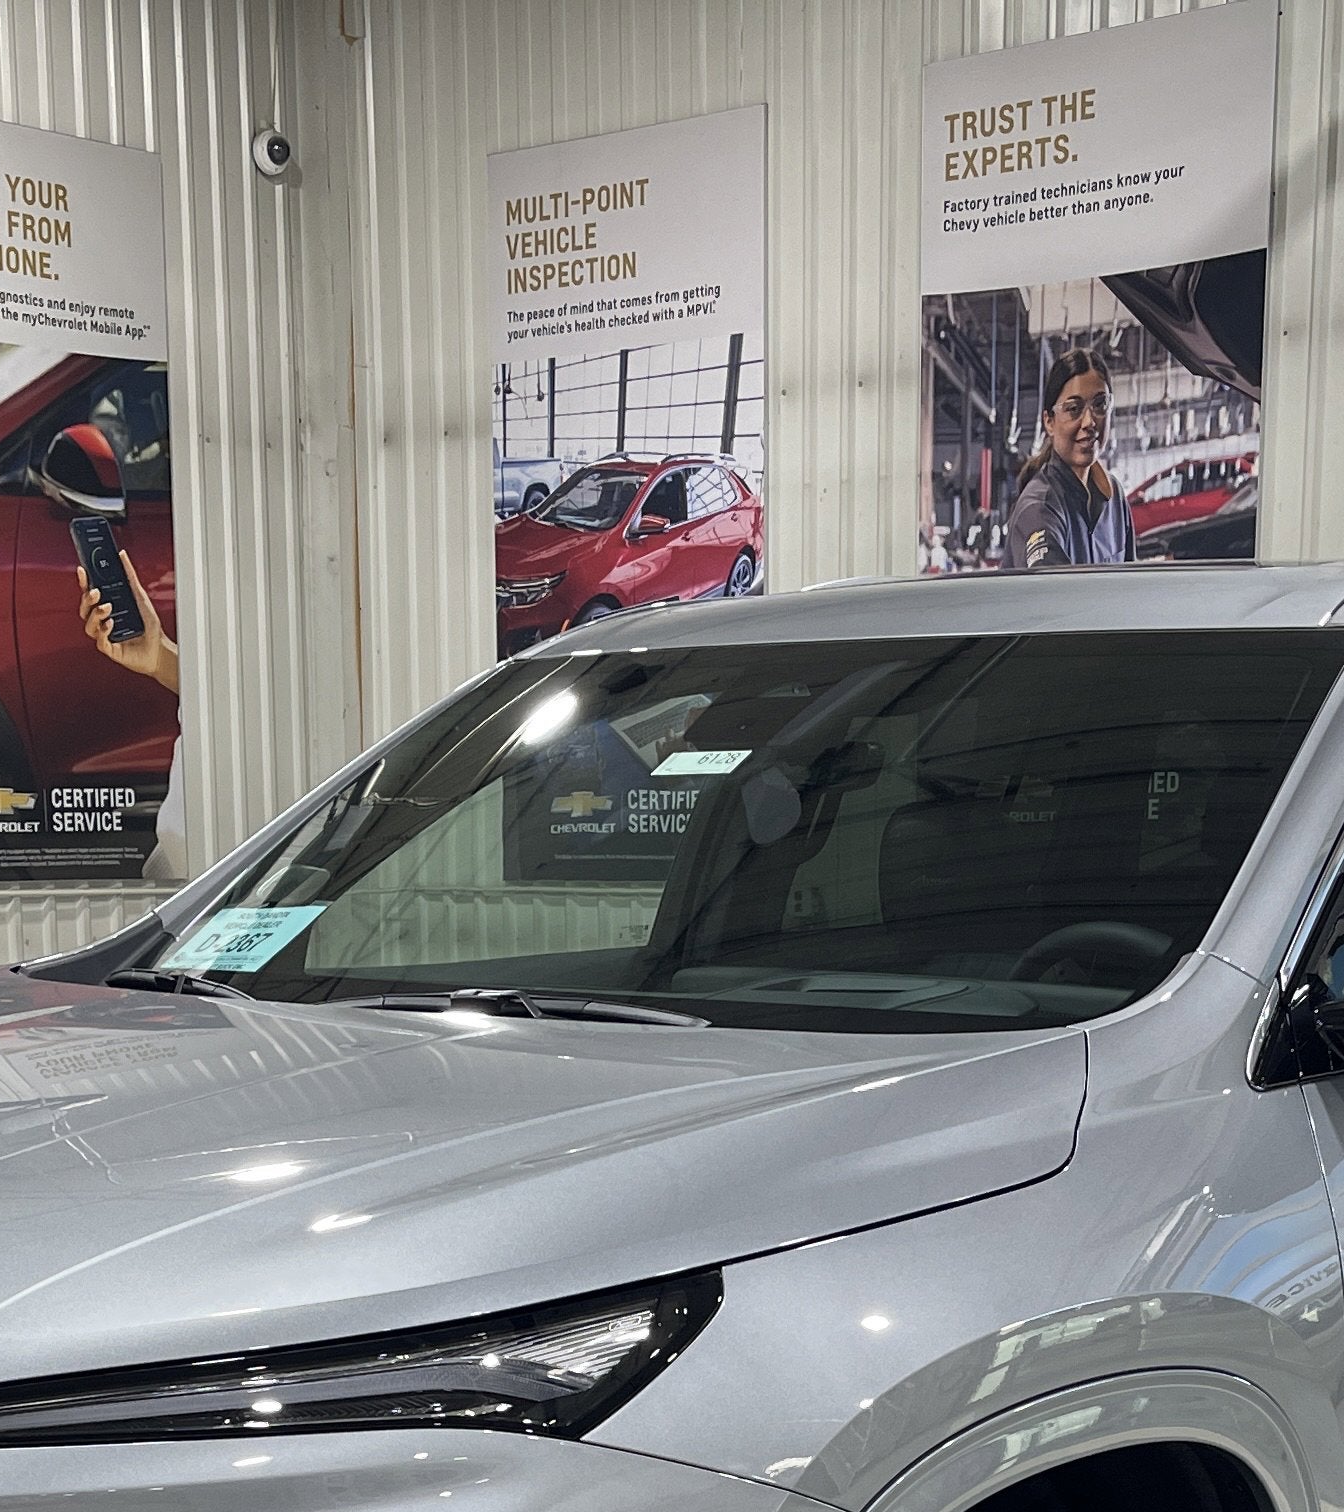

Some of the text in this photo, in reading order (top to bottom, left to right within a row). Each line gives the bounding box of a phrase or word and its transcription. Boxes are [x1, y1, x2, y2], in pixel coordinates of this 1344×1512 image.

[944, 88, 1097, 144] TRUST THE
[944, 133, 1079, 182] EXPERTS.
[4, 173, 69, 212] YOUR
[506, 178, 649, 226] MULTI-POINT
[943, 164, 1185, 215] Factory trained technicians know your
[7, 210, 72, 248] FROM
[943, 193, 1154, 233] Chevy vehicle better than anyone.
[506, 222, 597, 260] VEHICLE
[507, 251, 637, 295] INSPECTION
[0, 306, 20, 321] the
[21, 310, 89, 332] myChevrolet
[90, 318, 123, 336] Mobile
[46, 294, 66, 311] and
[68, 300, 97, 318] enjoy
[98, 304, 135, 321] remote
[507, 284, 721, 324] The peace of mind that comes from getting
[507, 328, 529, 343] your
[530, 320, 573, 337] vehicle's
[574, 316, 606, 331] health
[608, 311, 650, 328] checked
[652, 306, 676, 322] with
[677, 308, 684, 319] a
[51, 787, 136, 808] CERTIFIED
[52, 811, 123, 832] SERVICE
[550, 823, 616, 834] CHEVROLET
[628, 813, 691, 833] SERVIC
